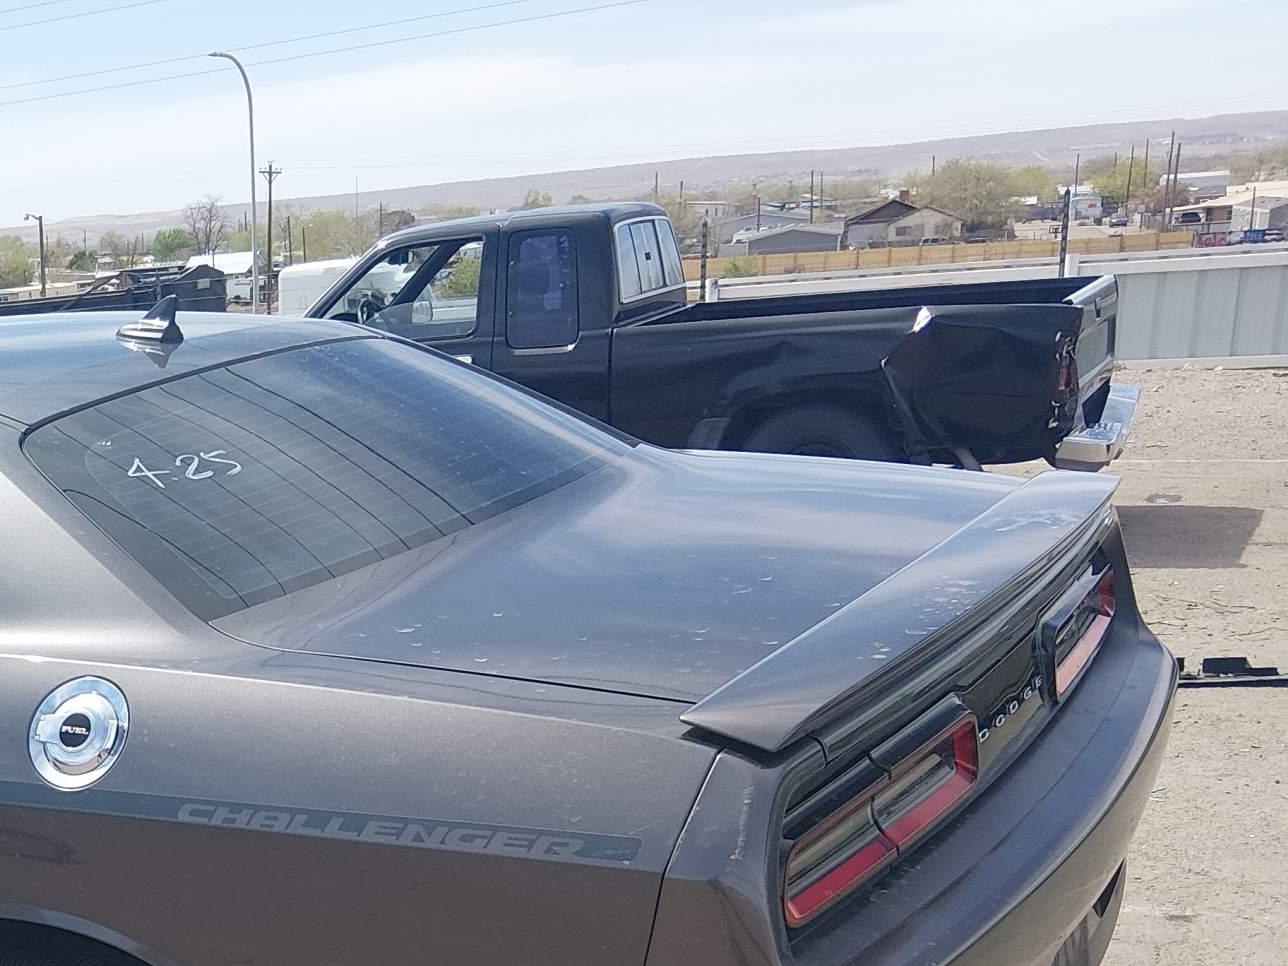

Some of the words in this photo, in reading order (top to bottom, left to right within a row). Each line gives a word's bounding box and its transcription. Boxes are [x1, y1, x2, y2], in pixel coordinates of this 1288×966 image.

[61, 725, 89, 735] FUEL
[978, 675, 1042, 743] DODGE
[177, 803, 584, 858] CHALLENGER
